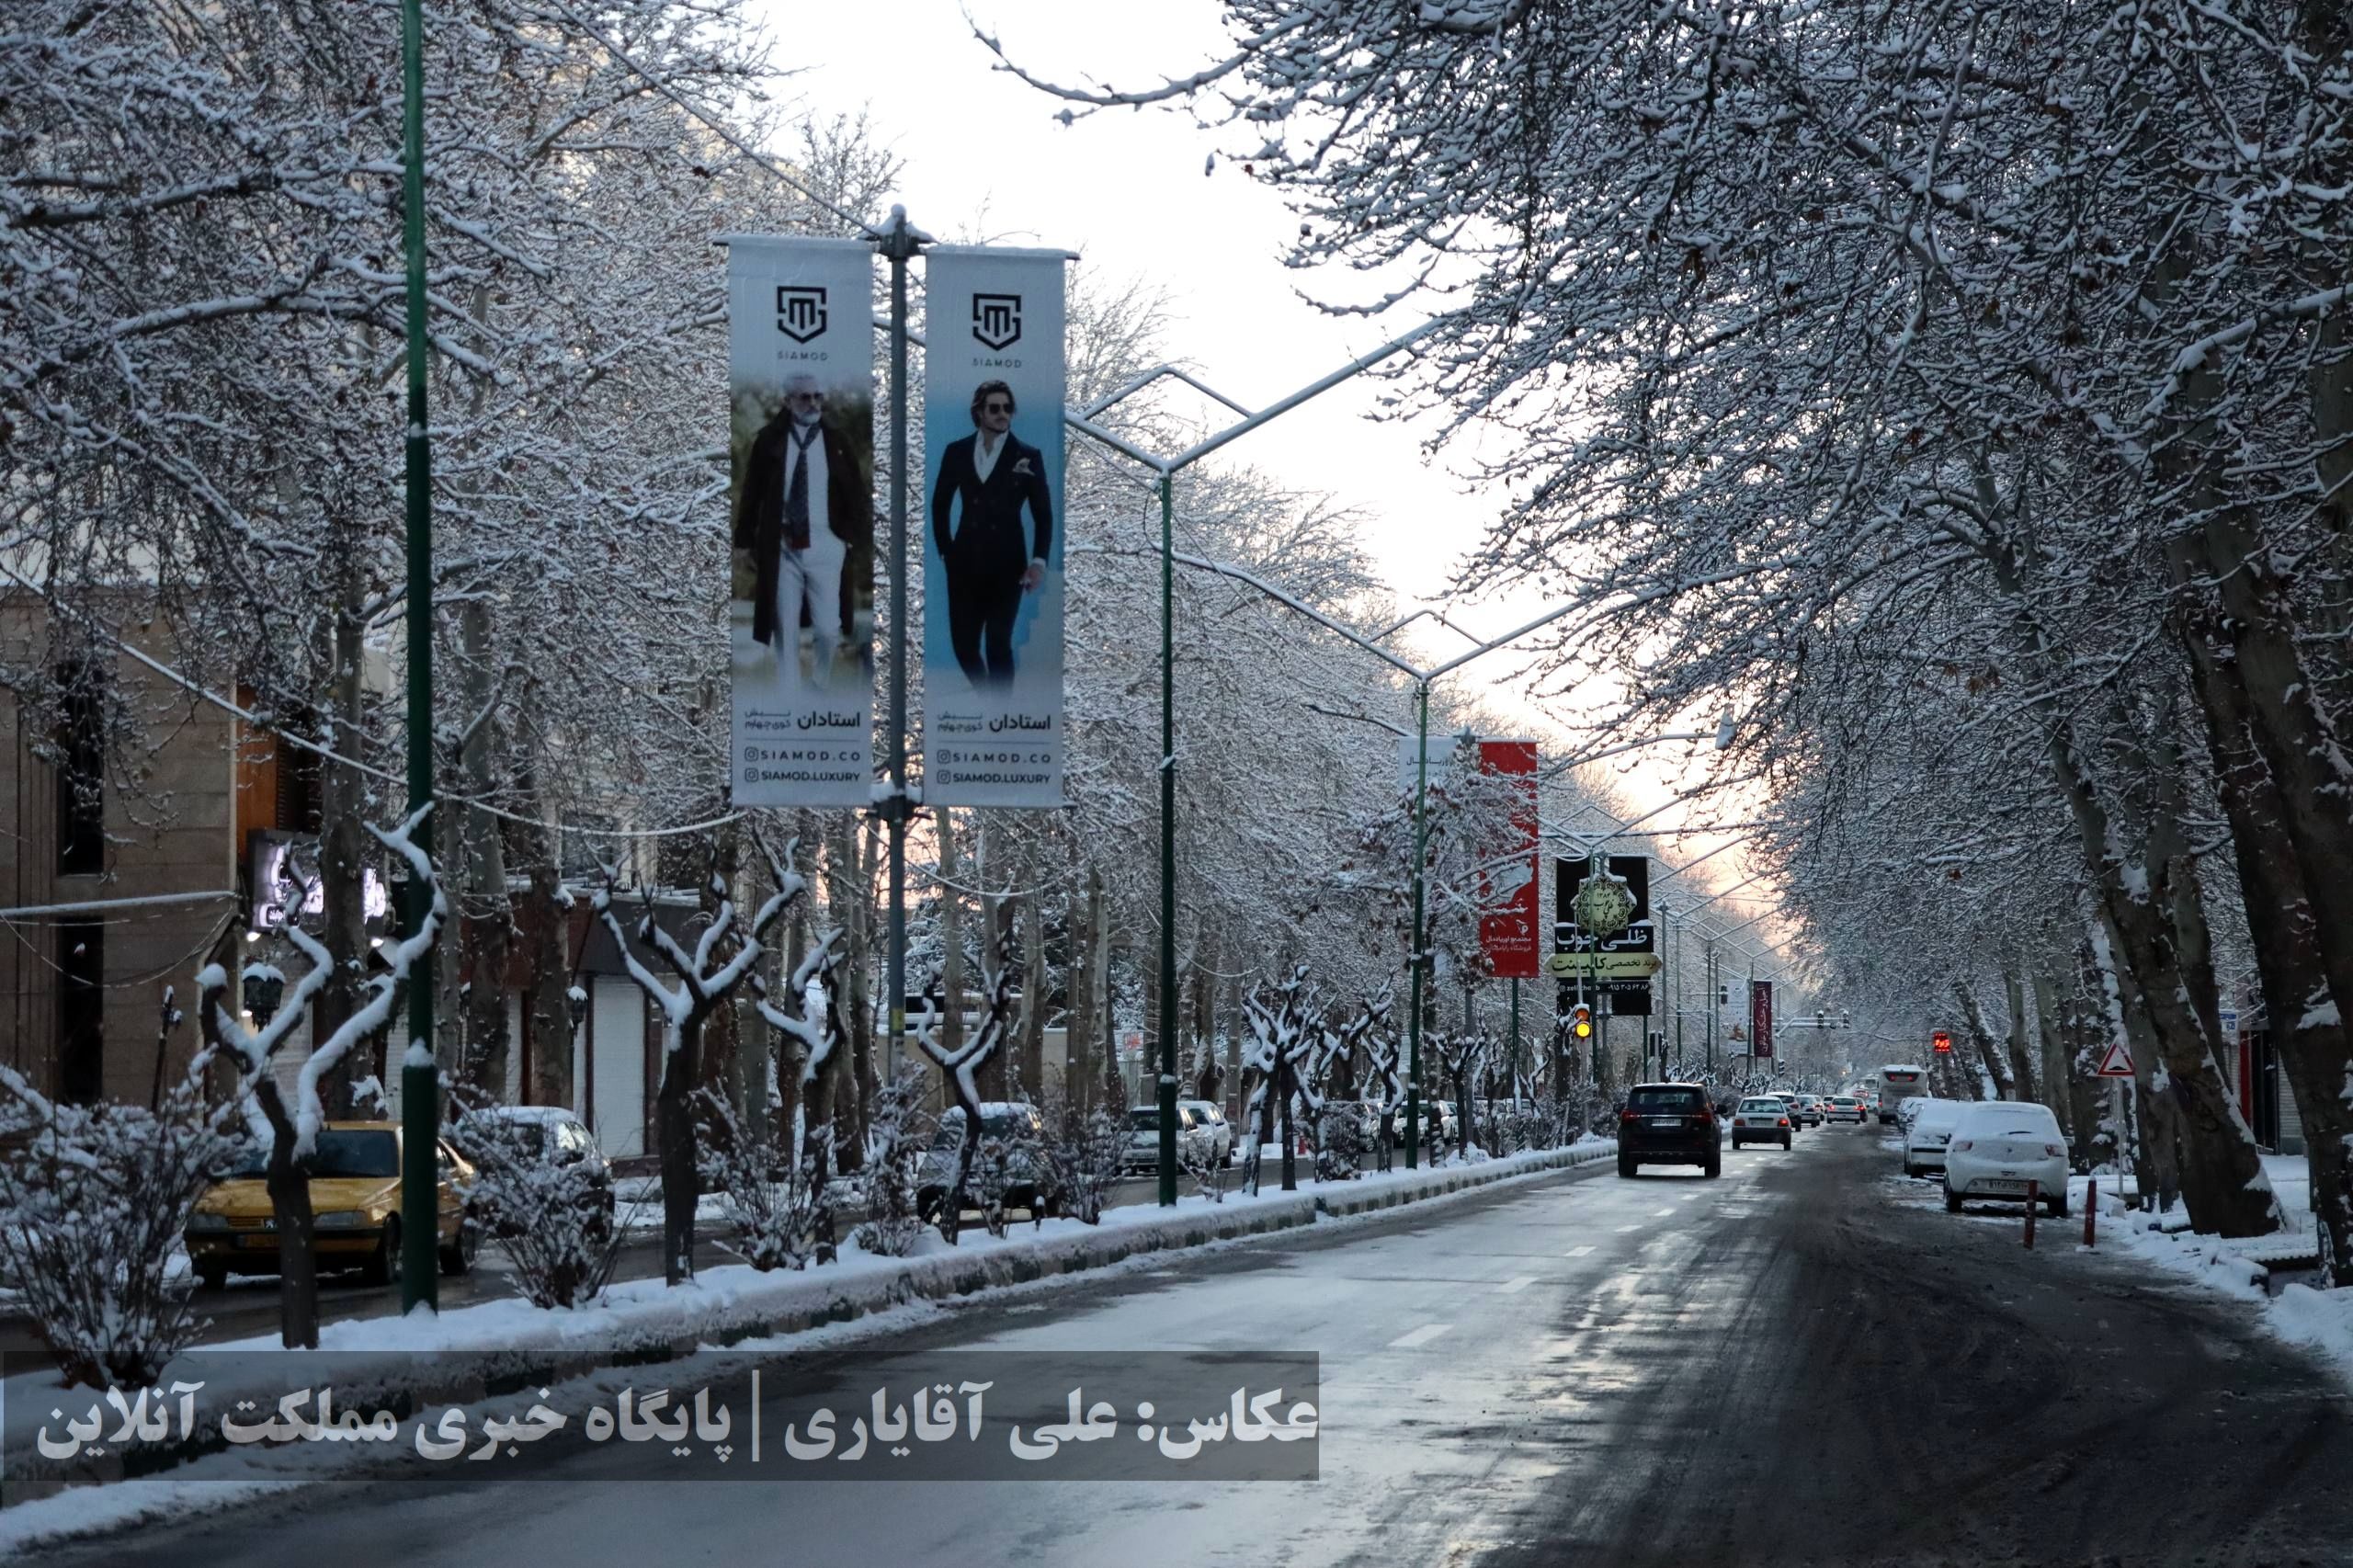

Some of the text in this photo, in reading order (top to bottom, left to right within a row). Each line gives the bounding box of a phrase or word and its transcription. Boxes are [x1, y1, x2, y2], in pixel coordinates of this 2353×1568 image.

[777, 350, 828, 361] SIAMOD
[972, 358, 1022, 369] SIAMOD
[797, 710, 861, 730] استادان
[989, 713, 1051, 733] استادان
[761, 750, 861, 762] SIAMOD.CO
[952, 753, 1051, 764] SIAMOD.CO
[761, 770, 861, 781] SIAMOD.LUXURY
[952, 773, 1051, 784] SIAMOD.LUXURY
[1600, 928, 1648, 951] ظلی
[1606, 959, 1640, 971] تخصصی
